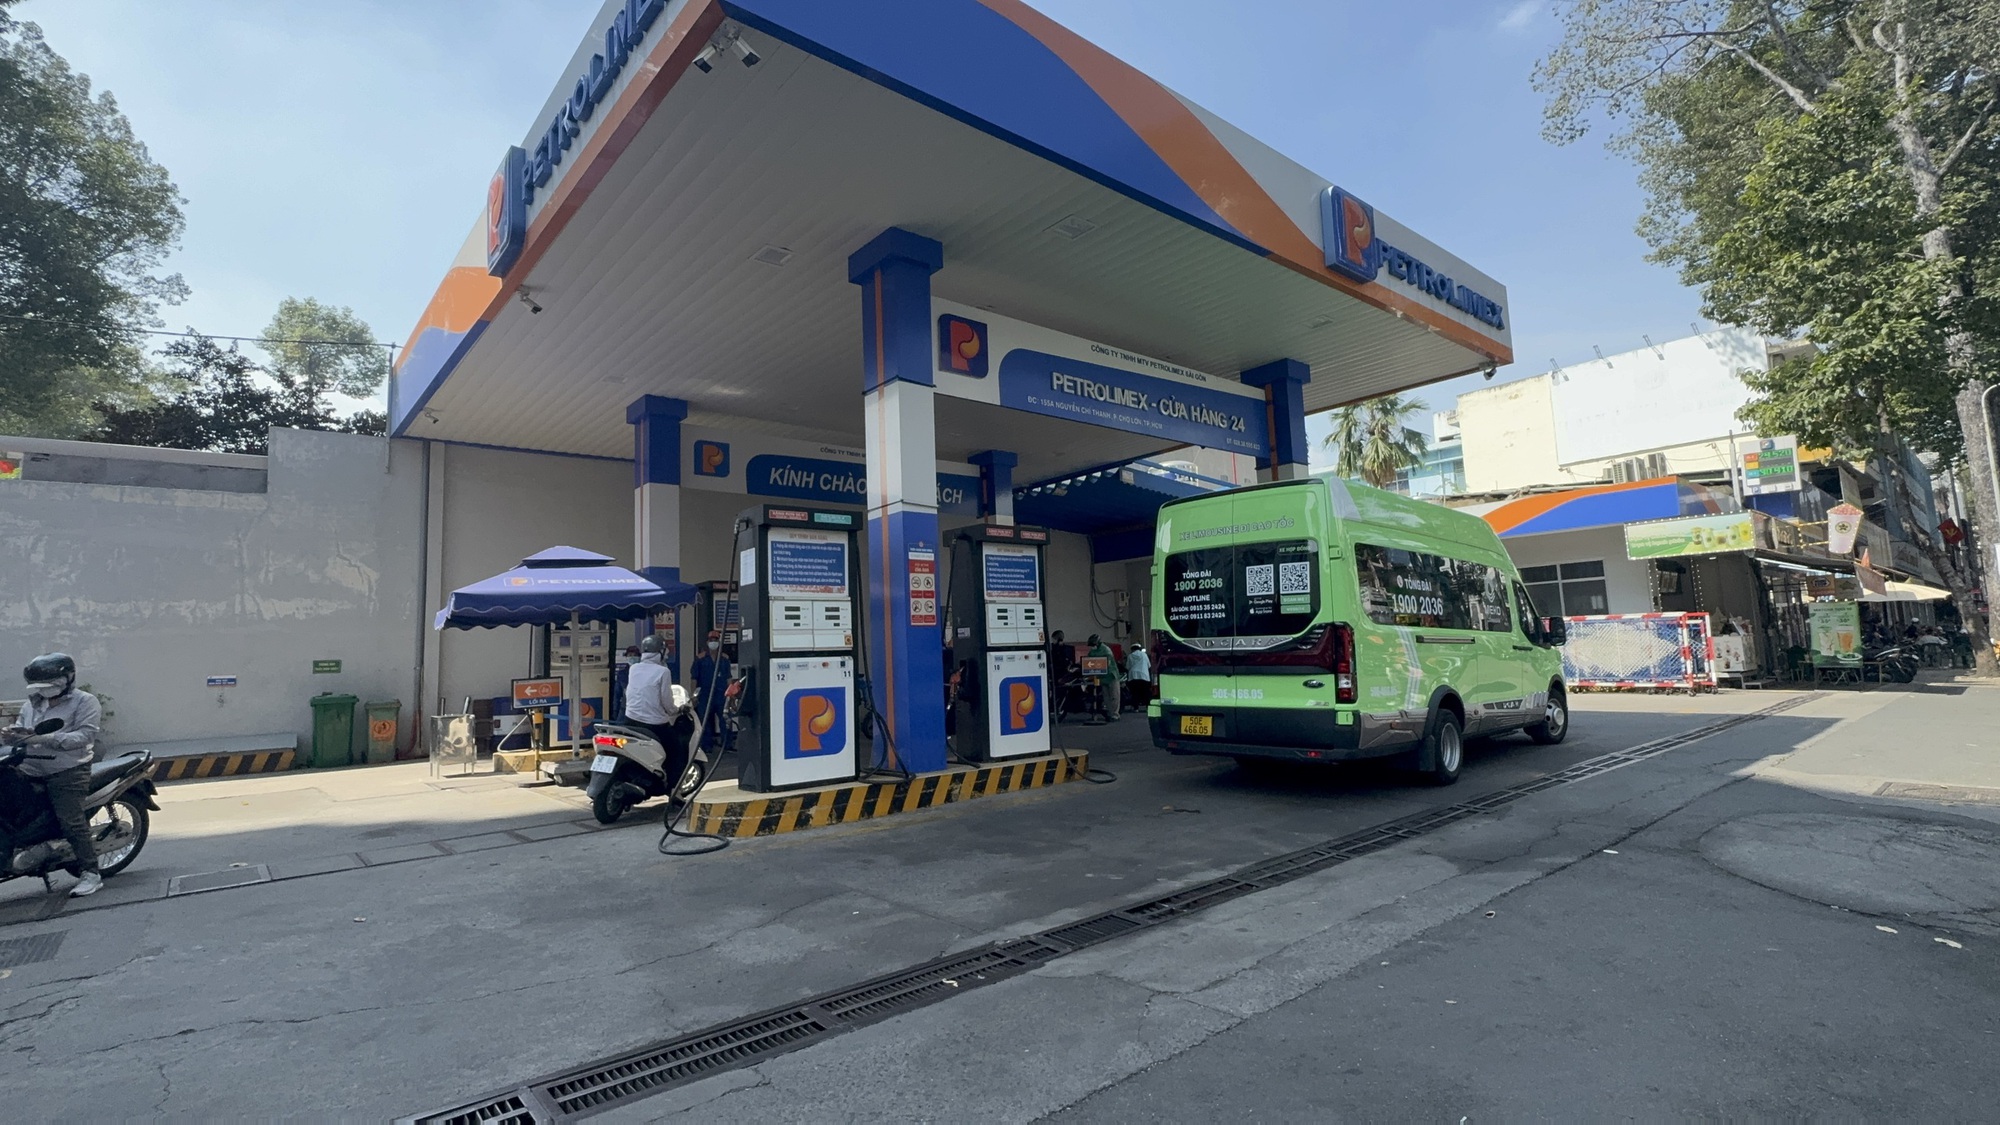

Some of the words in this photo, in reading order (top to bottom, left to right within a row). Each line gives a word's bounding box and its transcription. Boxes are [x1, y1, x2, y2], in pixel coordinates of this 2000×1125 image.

[521, 0, 669, 205] PETROLIM
[1376, 237, 1505, 331] PETROLIMEX
[1091, 344, 1110, 356] CÔNG
[1111, 350, 1119, 358] TY
[1120, 352, 1136, 363] TNHH
[1150, 361, 1184, 376] PETROLIMEX
[1040, 398, 1055, 408] 155A
[1052, 371, 1149, 411] PETROLIMEX
[1159, 394, 1188, 419] CỬA
[1191, 404, 1228, 428] HÀNG
[1231, 416, 1246, 432] 24
[769, 464, 815, 488] KÍNH
[819, 471, 868, 494] CHÀO
[1192, 524, 1240, 540] LIMOUSINE
[1251, 520, 1273, 531] CAO
[1274, 515, 1294, 529] TỐC
[537, 577, 650, 586] PETROLIMEX
[1174, 580, 1197, 591] 1900
[1198, 577, 1223, 589] 2036
[1183, 594, 1211, 602] HOTLINE
[1392, 594, 1417, 613] 1900
[1420, 596, 1444, 615] 2036
[844, 670, 851, 678] 11
[1183, 725, 1208, 734] 466.05
[1189, 716, 1203, 726] 50E
